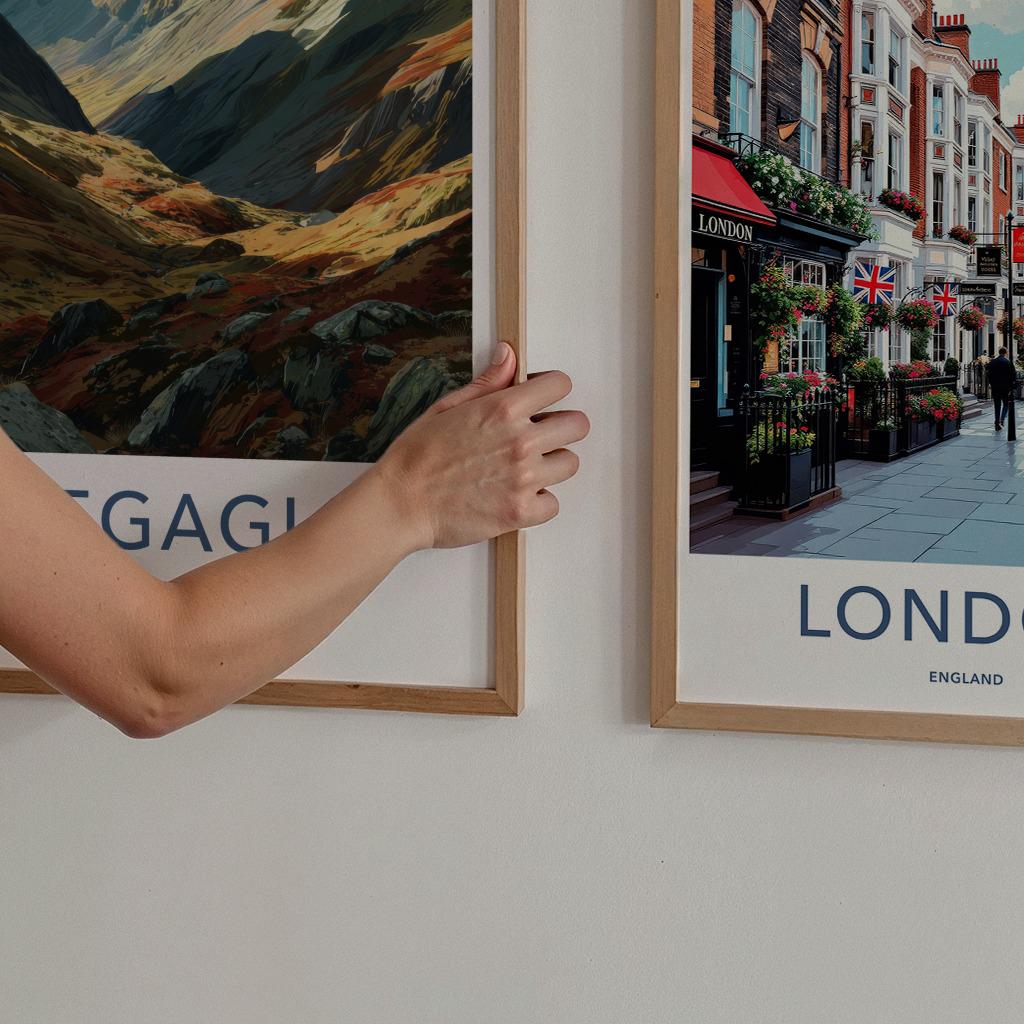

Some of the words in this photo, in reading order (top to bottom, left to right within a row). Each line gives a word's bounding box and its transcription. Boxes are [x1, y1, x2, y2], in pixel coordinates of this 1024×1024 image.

[698, 213, 753, 242] LONDON
[800, 584, 1024, 644] LOND
[929, 671, 1004, 686] ENGLAND
